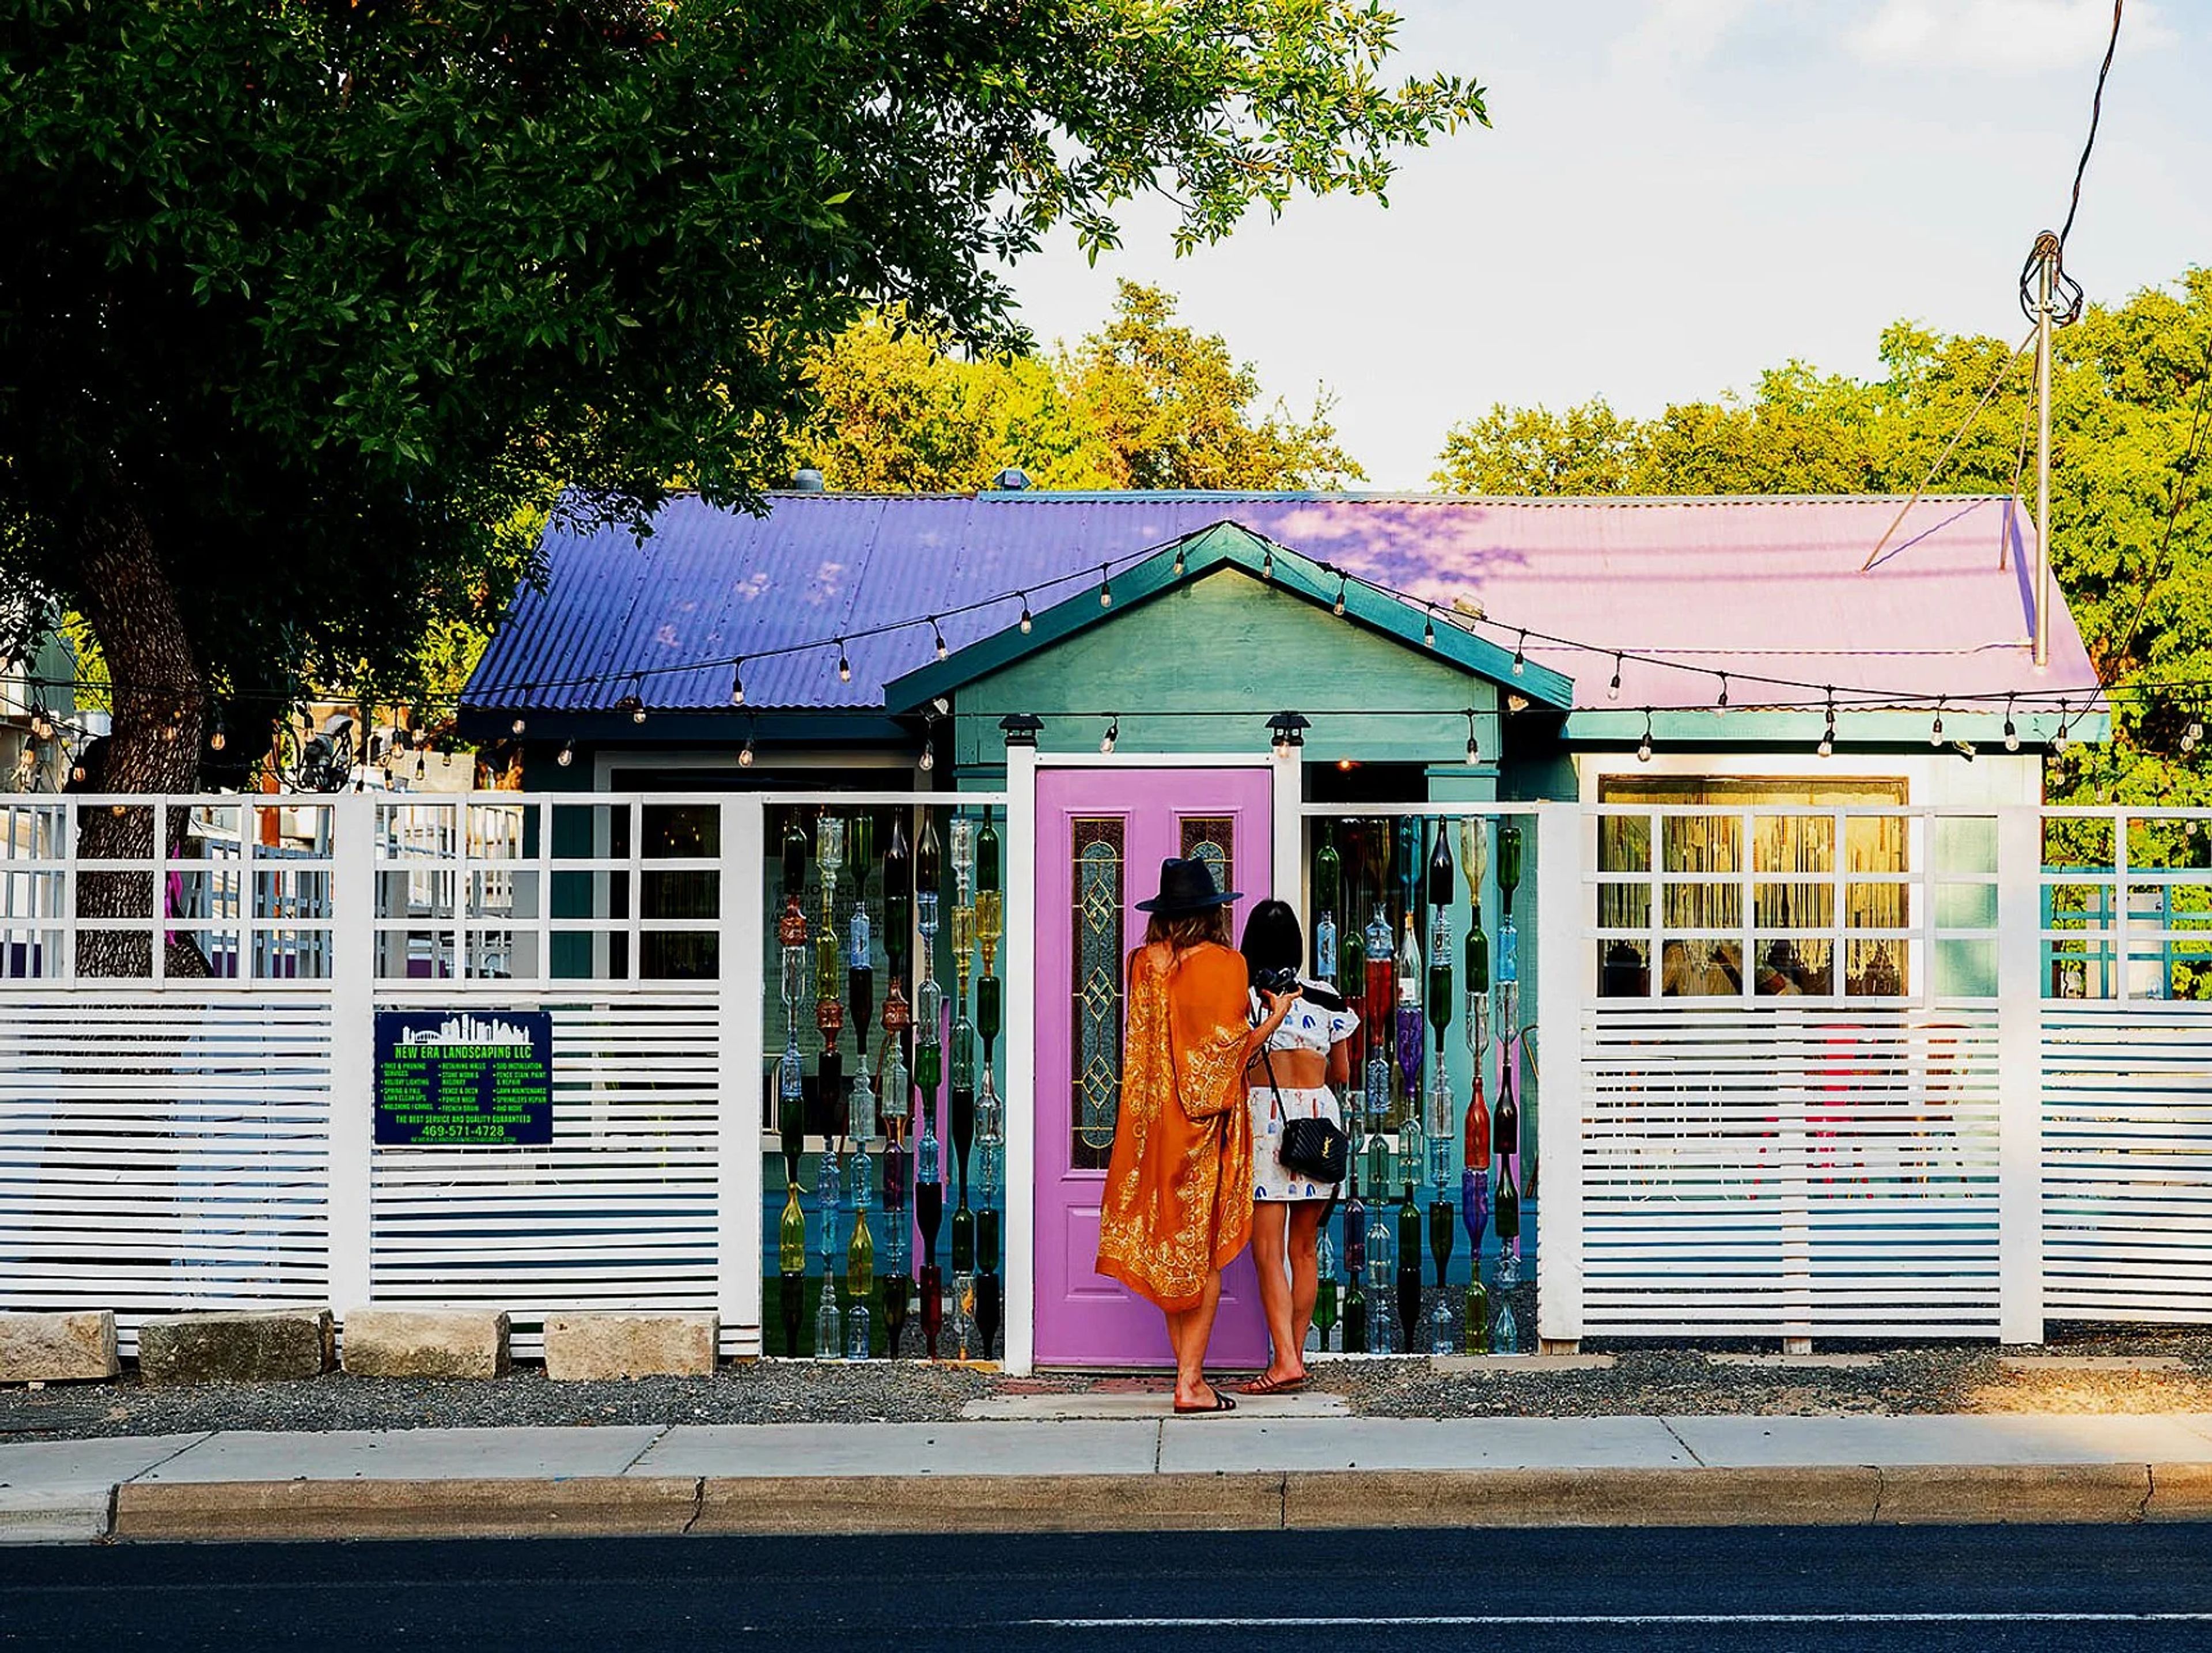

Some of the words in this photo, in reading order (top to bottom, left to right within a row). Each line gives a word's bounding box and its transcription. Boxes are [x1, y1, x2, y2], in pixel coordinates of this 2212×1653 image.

[395, 1046, 418, 1059] NEW
[421, 1046, 440, 1059] ERA
[443, 1046, 511, 1059] LANDSCAPING
[514, 1046, 532, 1059] LLC
[396, 1115, 407, 1124] THE
[409, 1115, 423, 1124] BEST
[426, 1115, 450, 1124] SERVICE
[452, 1115, 464, 1124] AND
[465, 1115, 490, 1124] QUALITY
[422, 1125, 505, 1136] 469-571-4728
